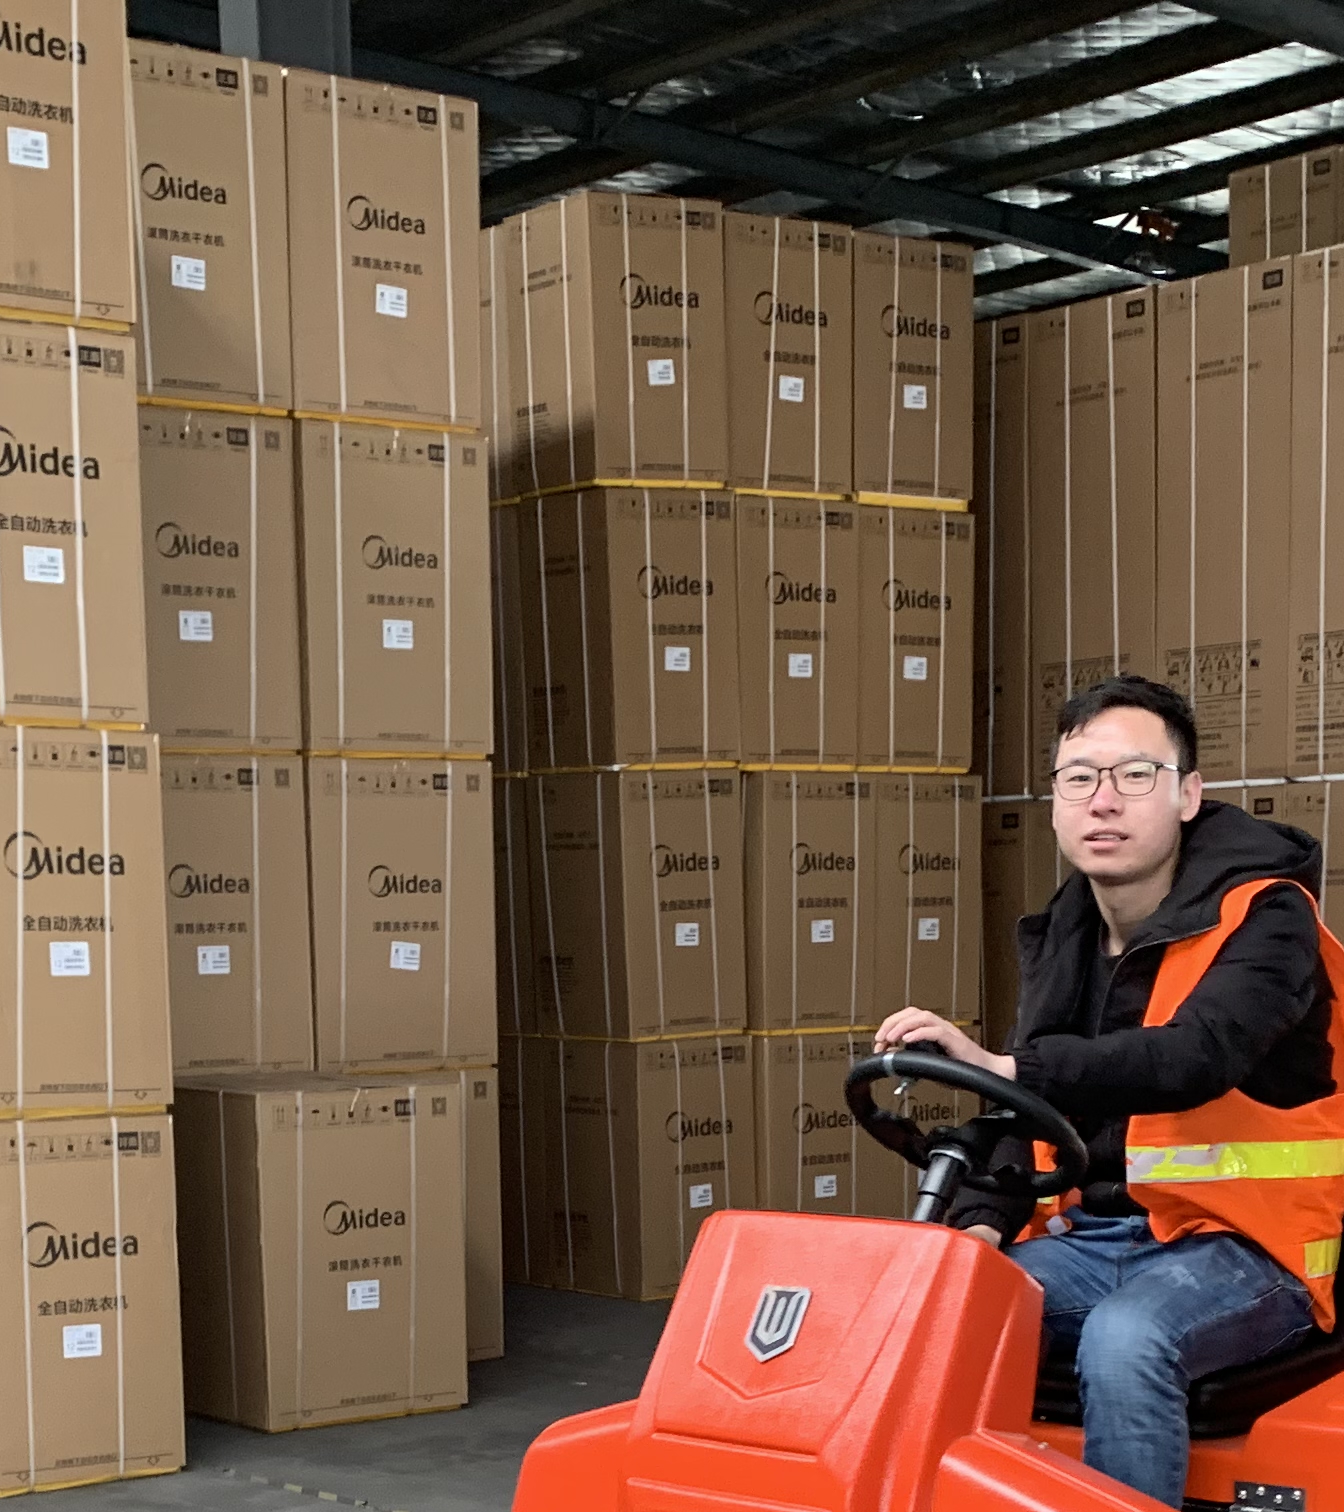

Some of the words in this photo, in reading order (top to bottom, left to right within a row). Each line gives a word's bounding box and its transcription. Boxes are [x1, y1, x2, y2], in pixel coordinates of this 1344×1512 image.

[141, 163, 226, 205] Midea
[347, 195, 426, 235] Midea
[620, 273, 699, 308] Midea
[754, 291, 828, 327] Midea
[881, 304, 950, 340] Midea
[156, 522, 239, 558] Midea
[362, 535, 438, 570] Midea
[637, 565, 713, 600] Midea
[765, 571, 837, 605] Midea
[882, 578, 951, 611] Midea
[3, 831, 125, 880] Midea
[650, 844, 720, 878] Midea
[789, 842, 855, 875] Midea
[168, 863, 250, 898] Midea
[368, 865, 442, 898] Midea
[666, 1111, 732, 1142] Midea
[323, 1200, 406, 1236] Midea
[22, 1221, 139, 1268] Midea
